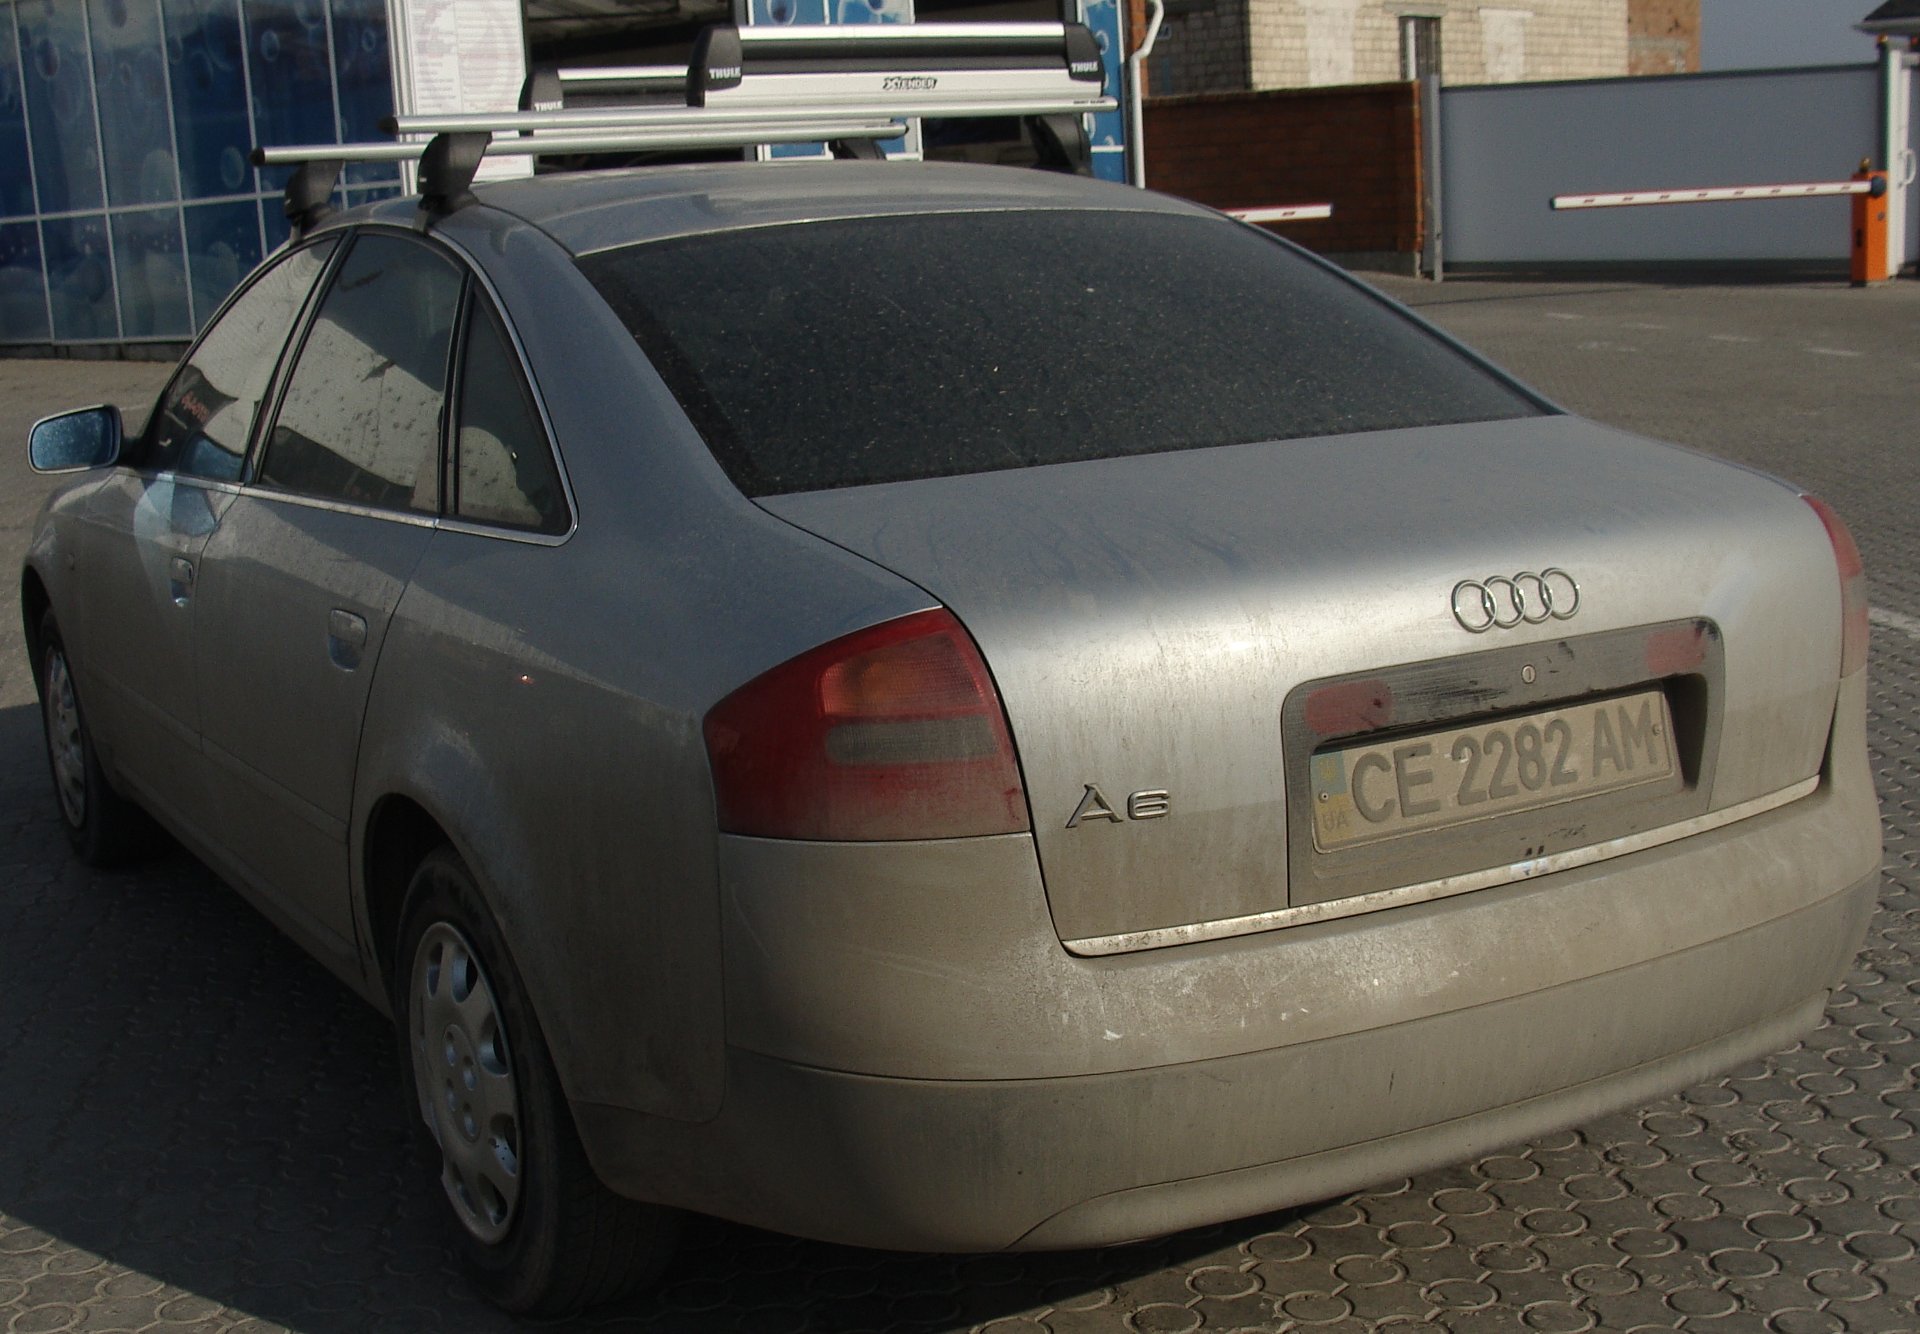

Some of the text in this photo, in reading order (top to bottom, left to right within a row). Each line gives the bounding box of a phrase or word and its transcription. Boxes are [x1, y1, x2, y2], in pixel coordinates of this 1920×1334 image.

[709, 66, 741, 79] THULE
[1071, 61, 1098, 72] THULE
[534, 100, 563, 112] THULE
[1352, 700, 1658, 822] CE 2282 AM
[1065, 782, 1169, 829] A6
[1322, 810, 1349, 832] UA
